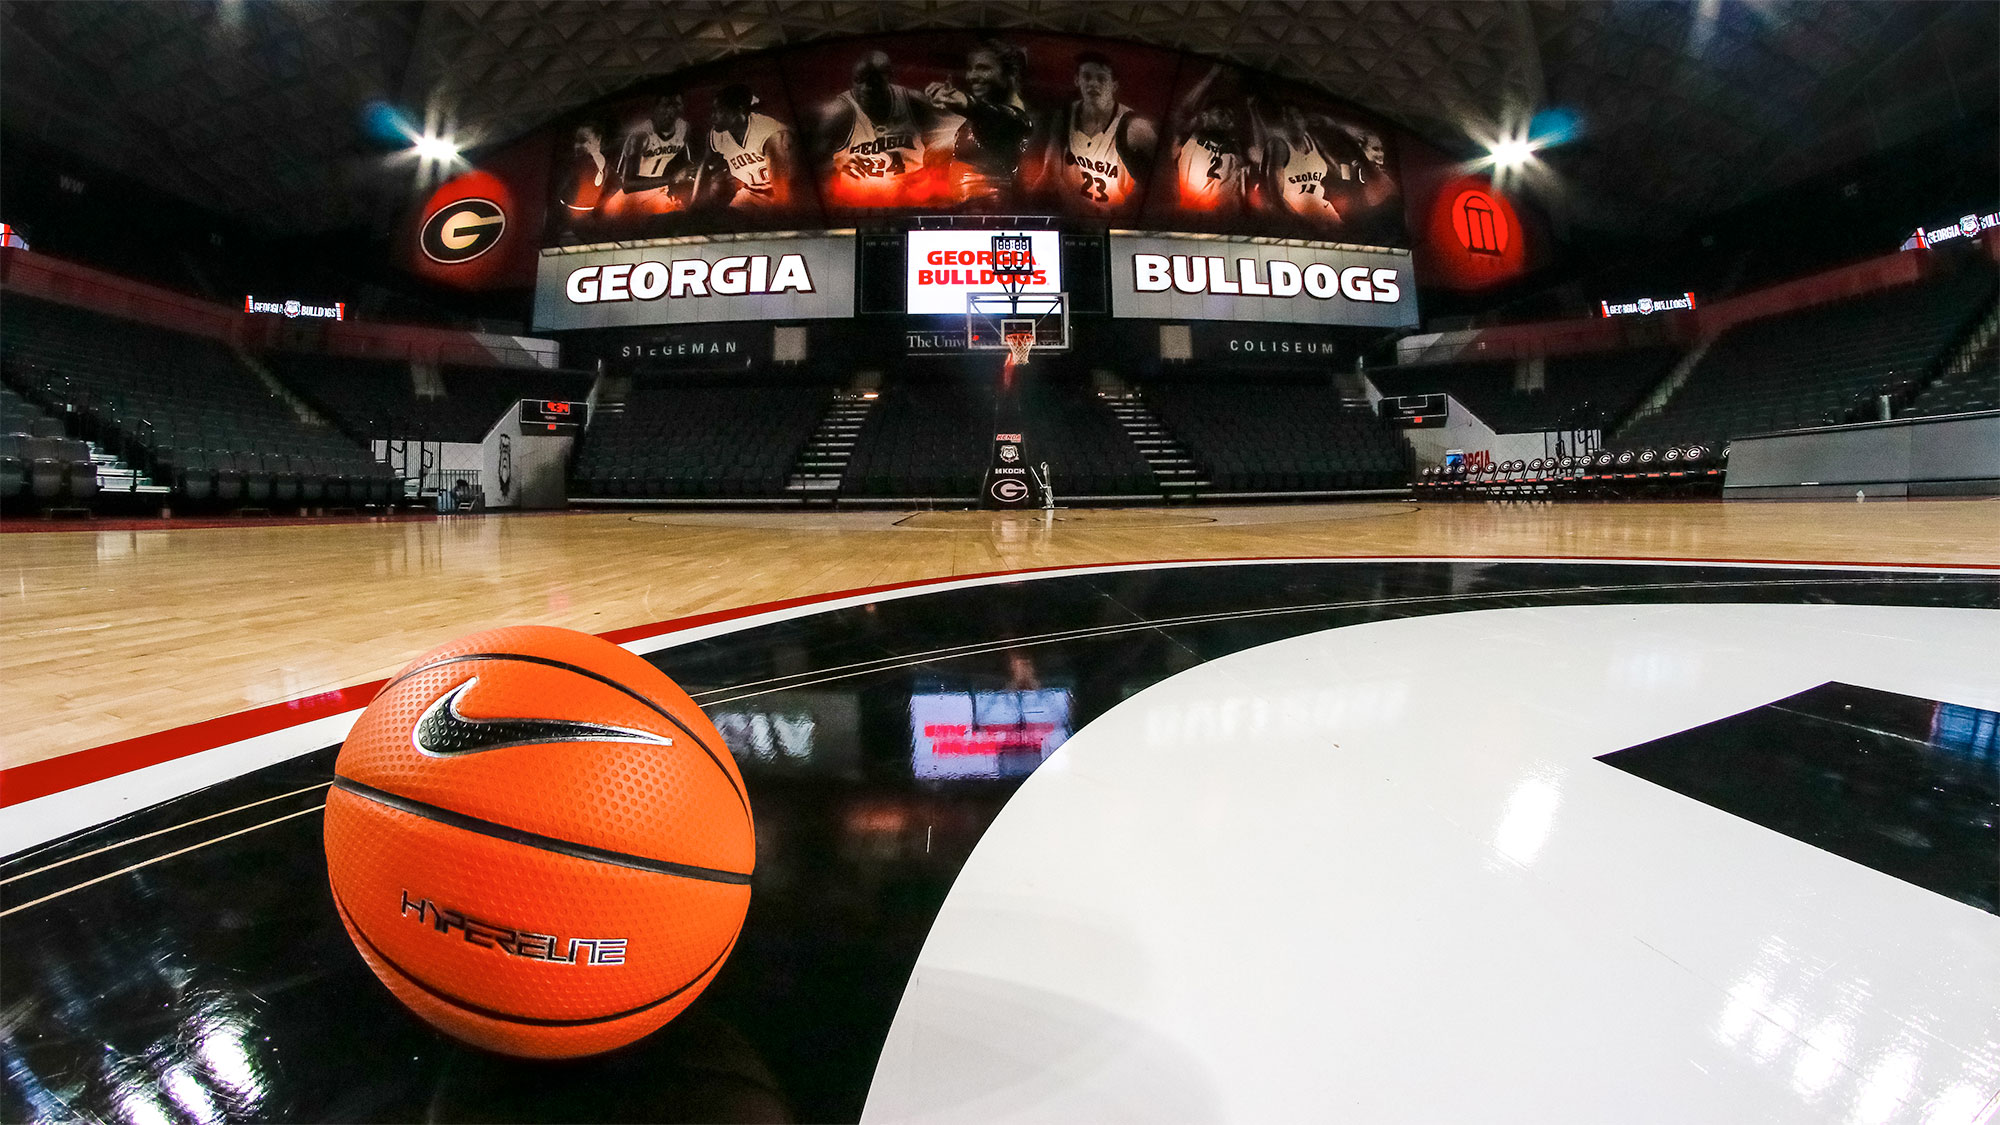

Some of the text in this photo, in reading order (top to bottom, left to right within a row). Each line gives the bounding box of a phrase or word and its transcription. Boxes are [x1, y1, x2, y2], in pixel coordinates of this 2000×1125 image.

[1207, 157, 1221, 179] 2
[1081, 172, 1109, 202] 23
[1926, 224, 1961, 244] GEORGIA
[927, 250, 1037, 266] GEORGIA
[565, 254, 816, 304] GEORGIA
[918, 269, 1047, 285] BULLDOGS
[1134, 254, 1400, 303] BULLDOGS
[622, 342, 736, 357] STEGEMAN
[906, 335, 932, 348] The
[1230, 340, 1334, 354] COLISEUM
[401, 888, 628, 967] HYPERELITE
